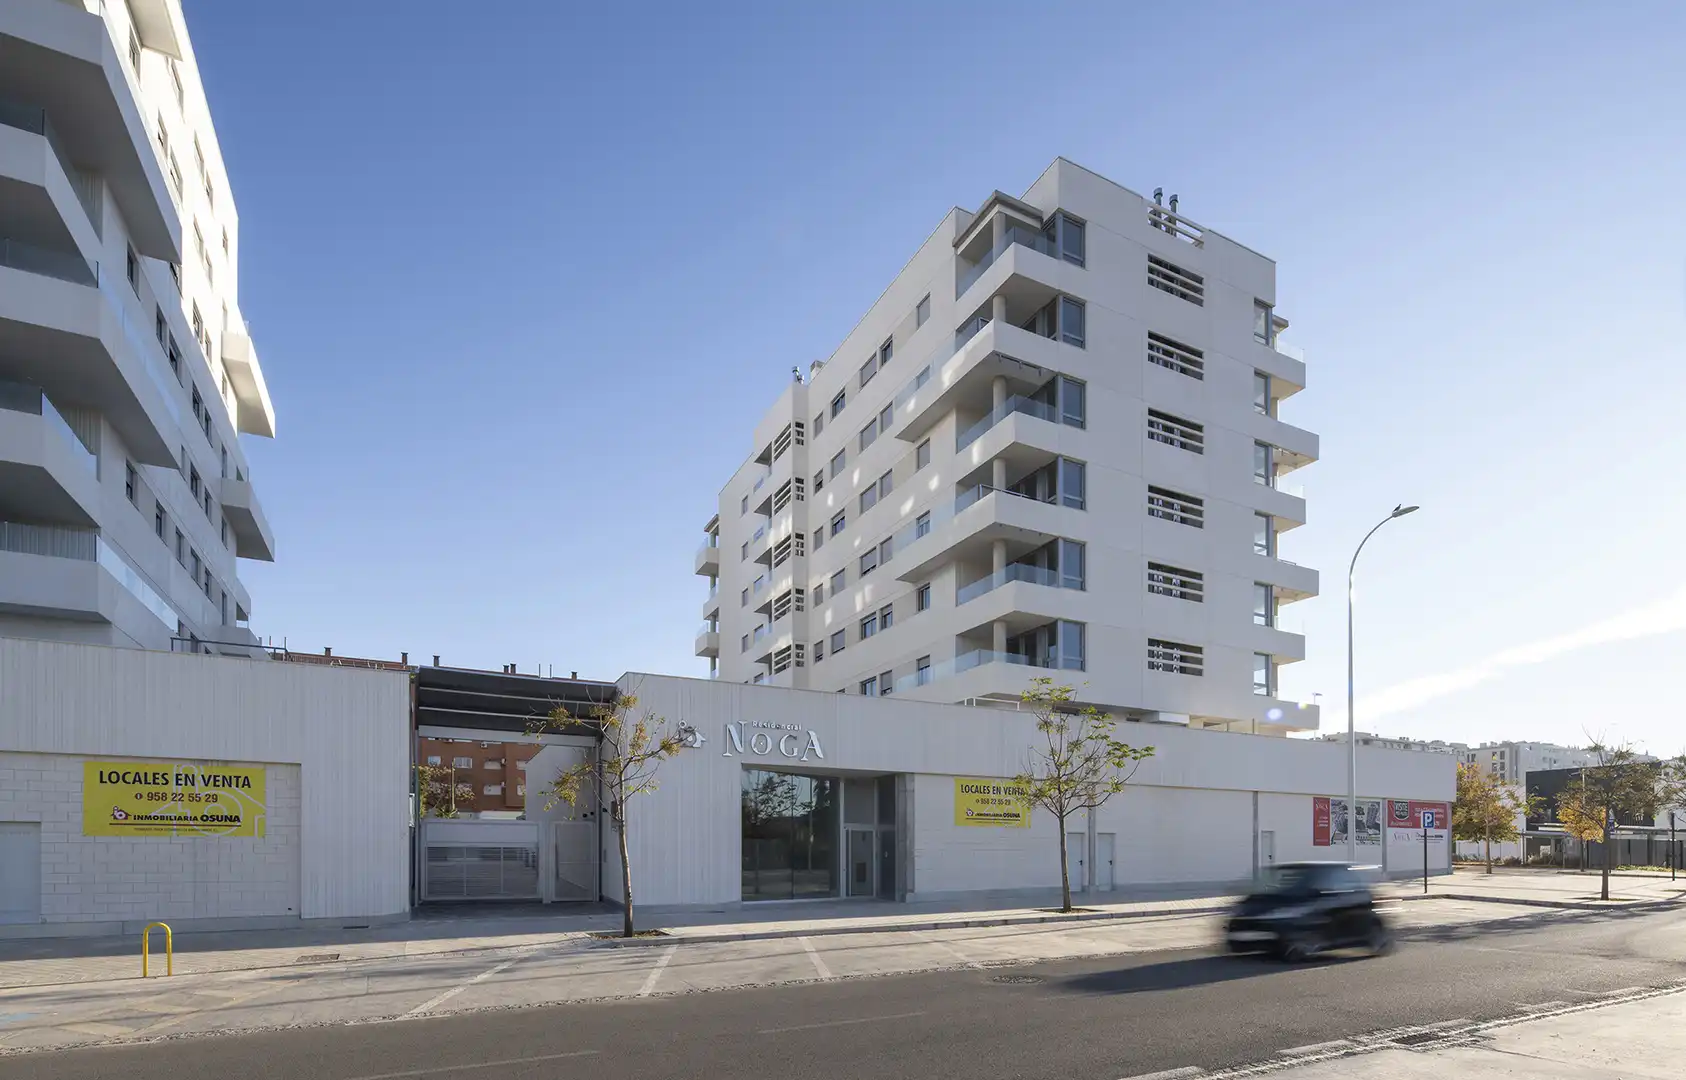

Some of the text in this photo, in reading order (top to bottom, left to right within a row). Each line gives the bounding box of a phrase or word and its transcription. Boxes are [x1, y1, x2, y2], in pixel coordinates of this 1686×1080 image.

[752, 720, 802, 731] Residencial
[722, 720, 824, 762] NOGA
[99, 770, 252, 788] LOCALES EN VENTA
[960, 784, 1026, 796] LOCALES EN VENTA
[147, 791, 218, 803] 958 22 55 29
[133, 814, 241, 823] INMOBILIARIA OSUNA
[1424, 813, 1433, 827] P
